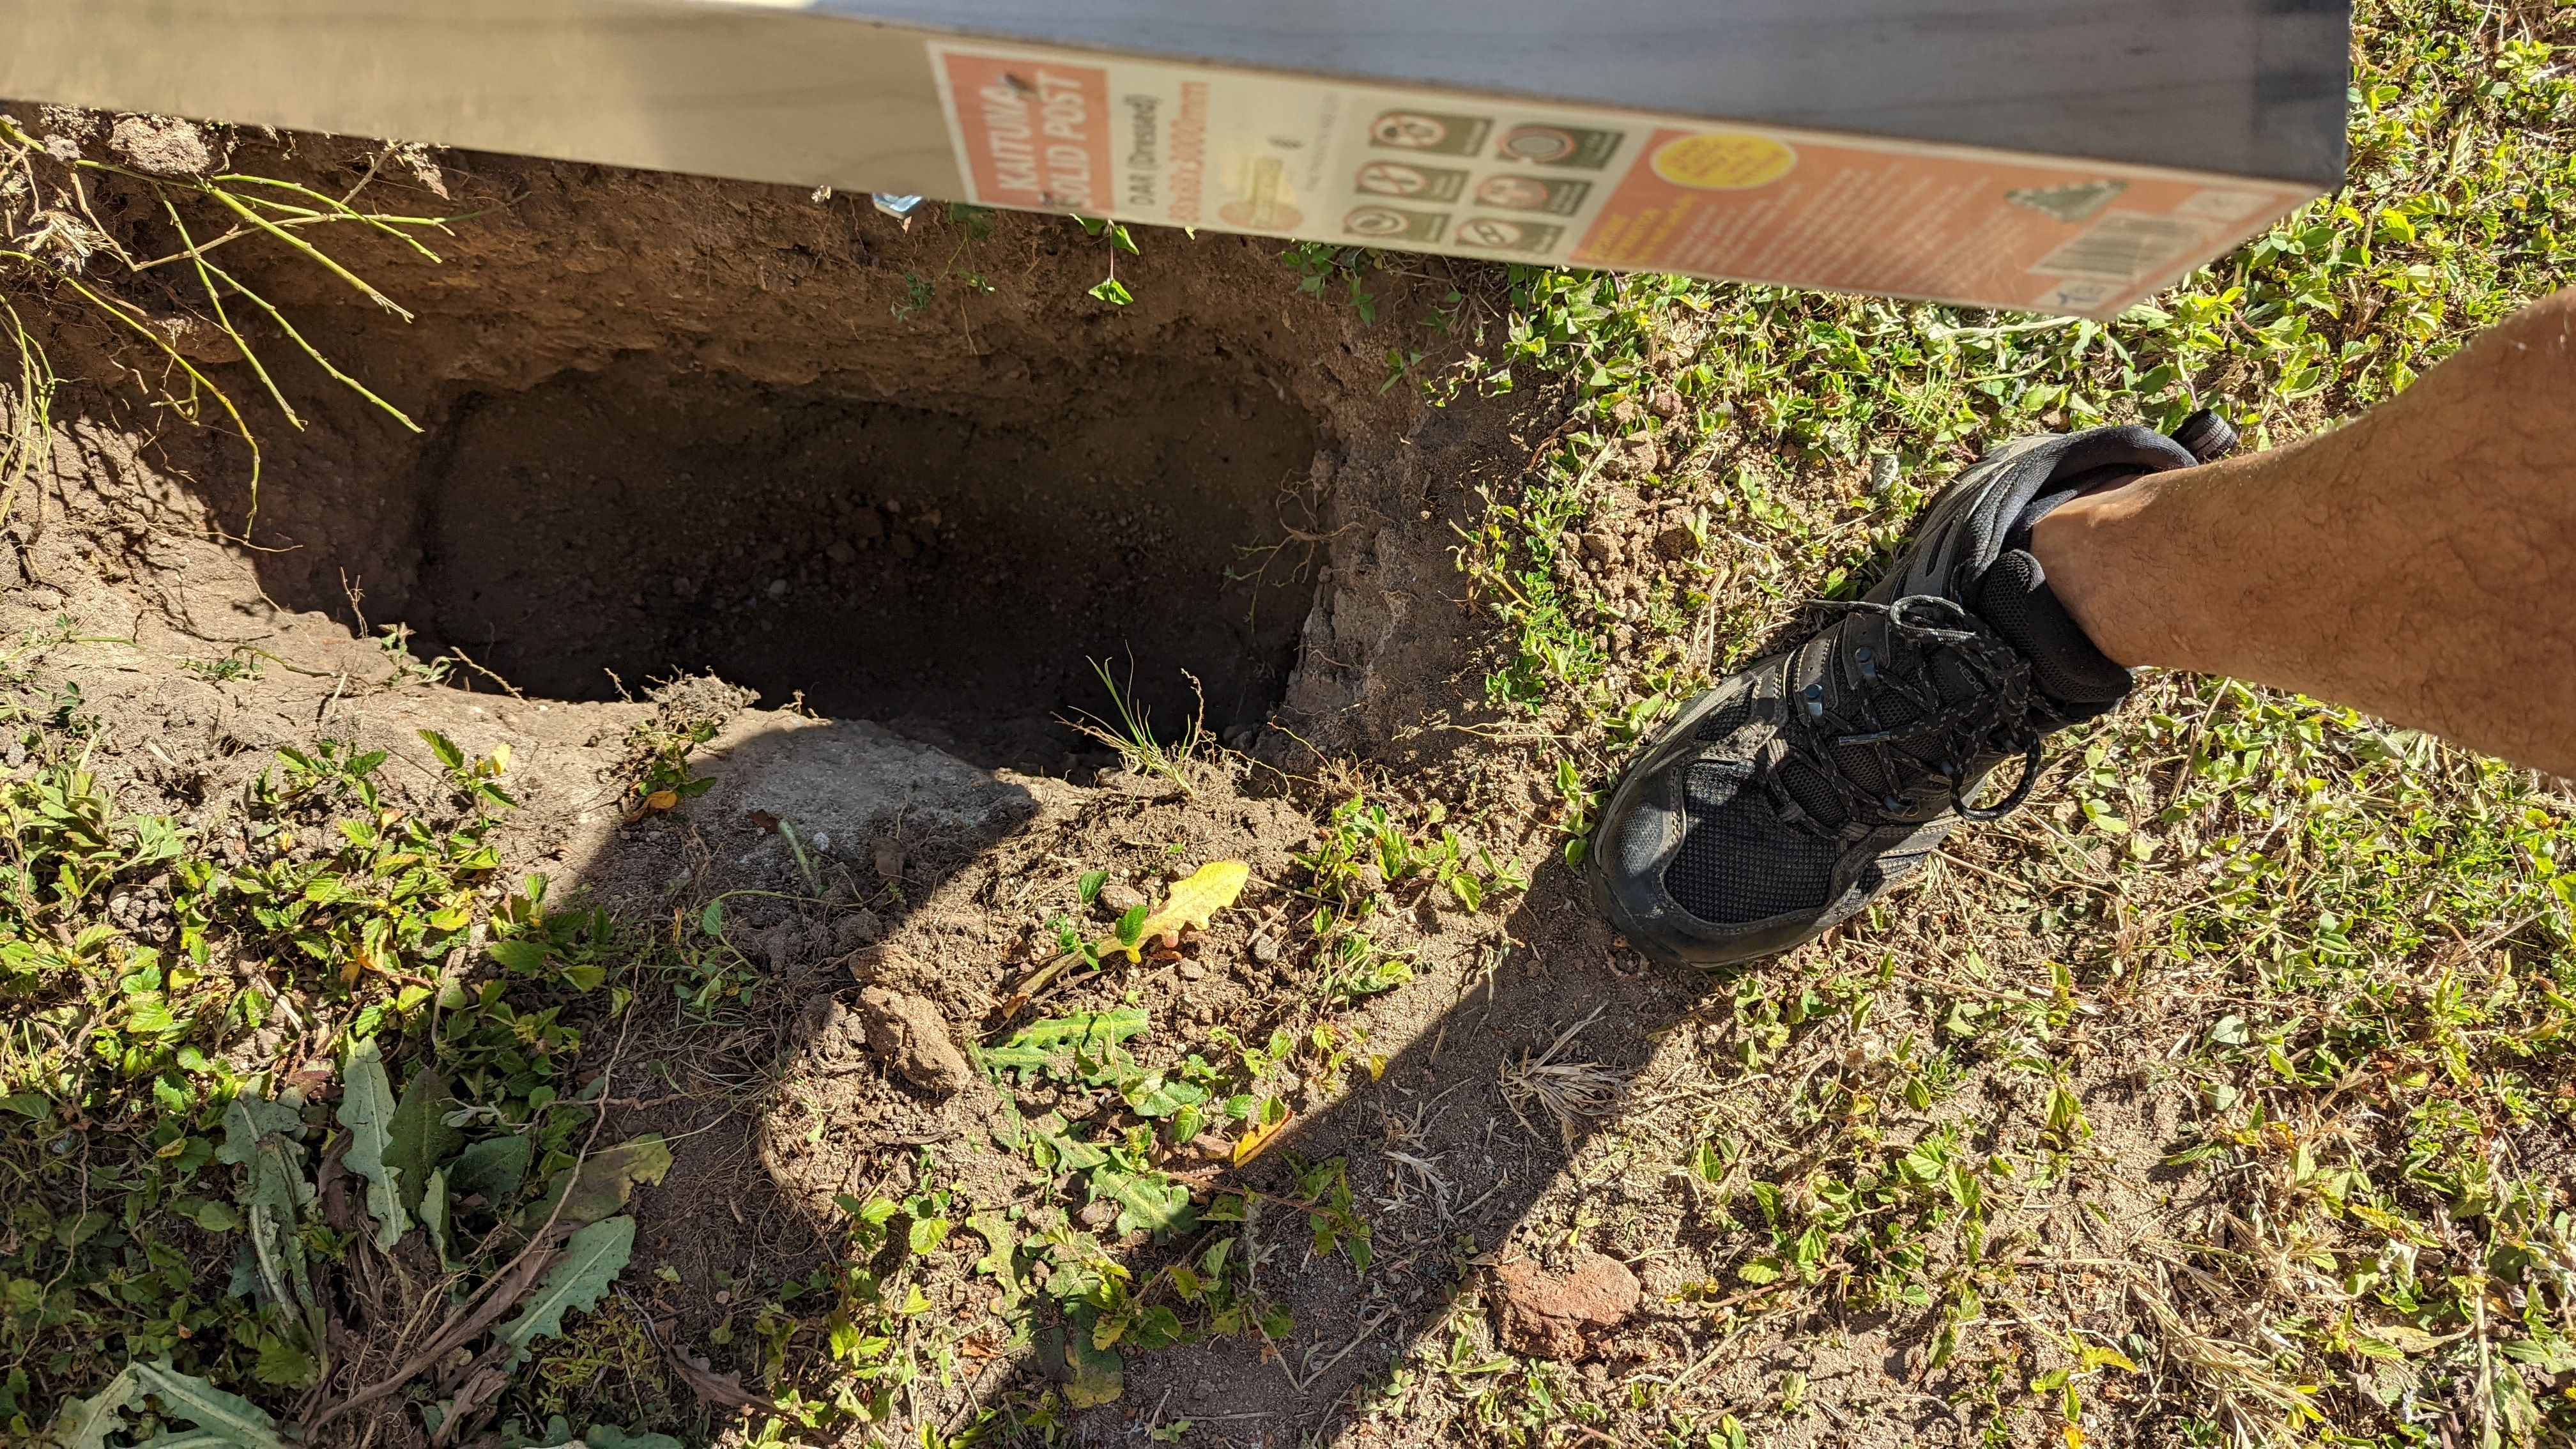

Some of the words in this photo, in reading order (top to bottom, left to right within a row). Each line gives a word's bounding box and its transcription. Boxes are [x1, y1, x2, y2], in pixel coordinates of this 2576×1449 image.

[979, 84, 1038, 191] KAITUNA
[1038, 72, 1087, 139] POST
[1124, 94, 1162, 171] (Dressed)
[1130, 173, 1154, 206] DAR
